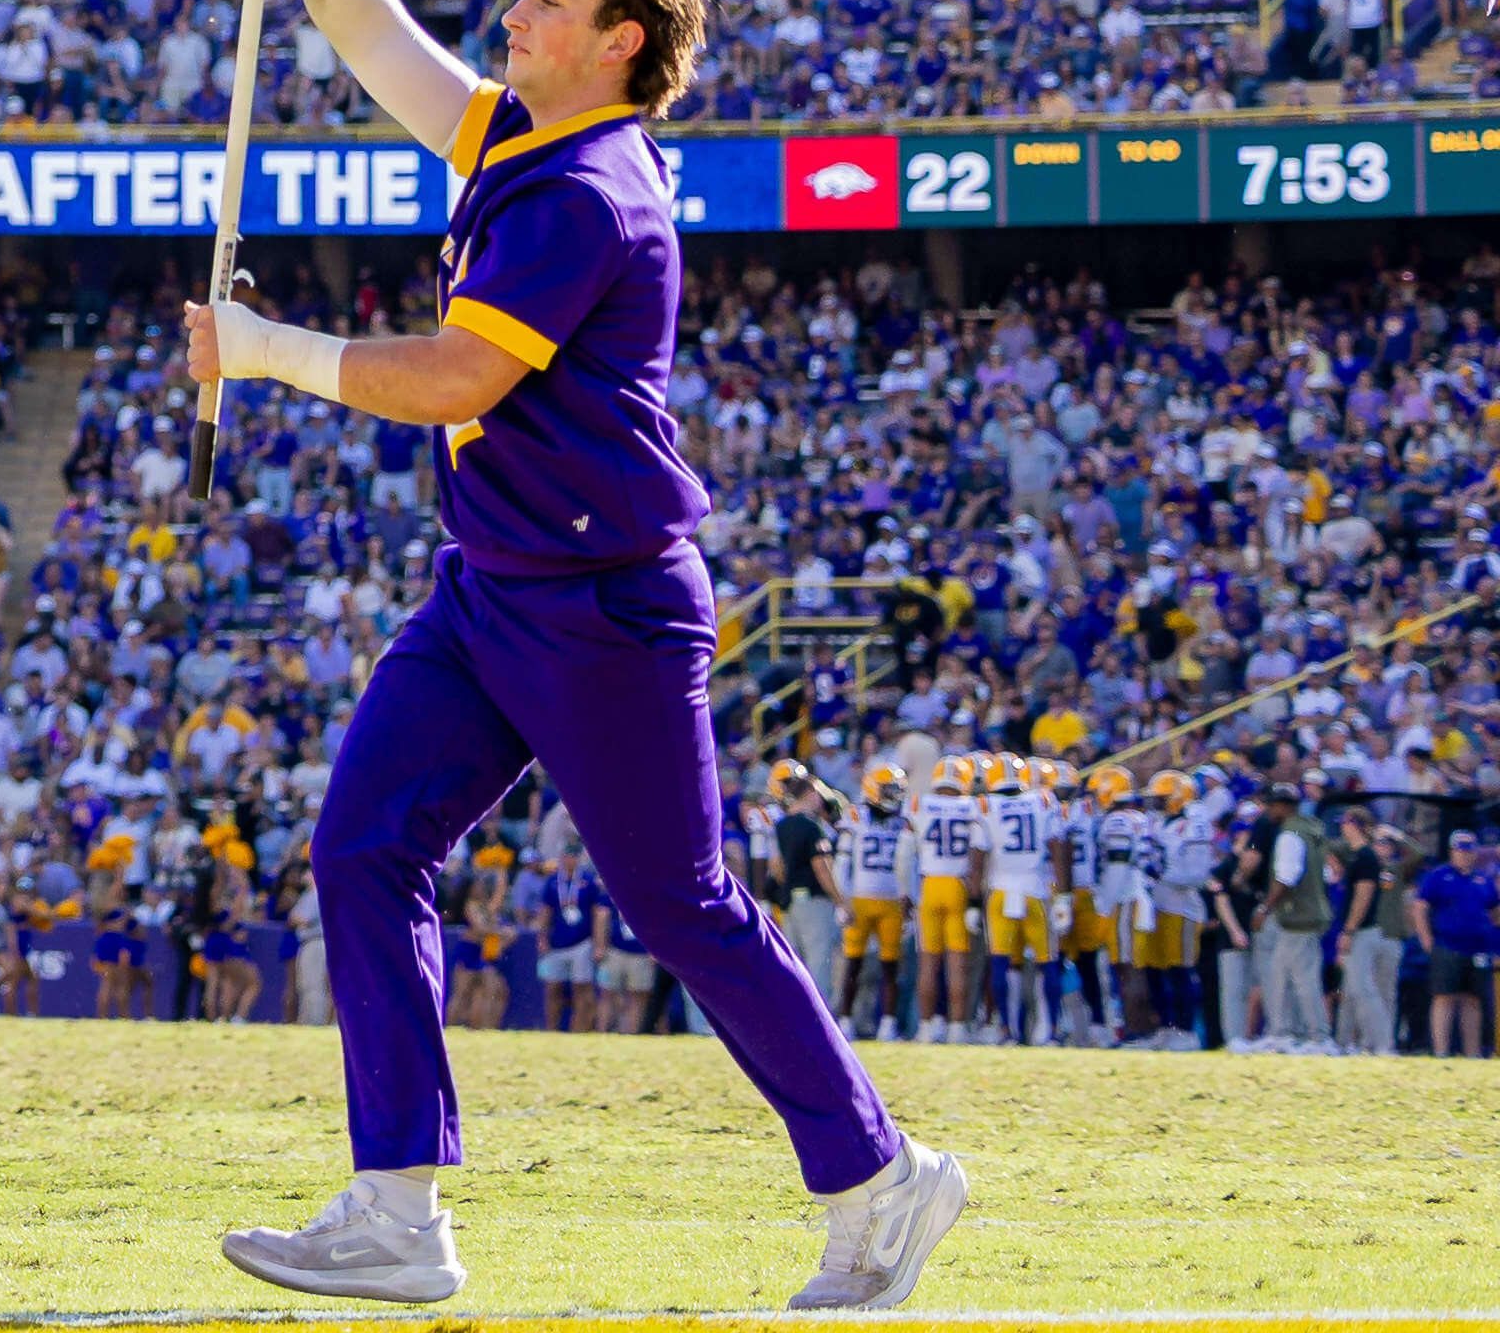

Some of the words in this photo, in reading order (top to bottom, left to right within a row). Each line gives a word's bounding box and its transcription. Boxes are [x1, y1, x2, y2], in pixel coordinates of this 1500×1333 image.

[1014, 142, 1081, 165] DOWN
[1116, 141, 1146, 163] TO
[1147, 140, 1182, 162] GO
[1430, 130, 1481, 153] BALL
[260, 151, 421, 226] THE
[905, 151, 992, 212] 22
[1237, 141, 1391, 206] 7:53
[923, 817, 970, 857] 46
[1000, 813, 1037, 852] 31
